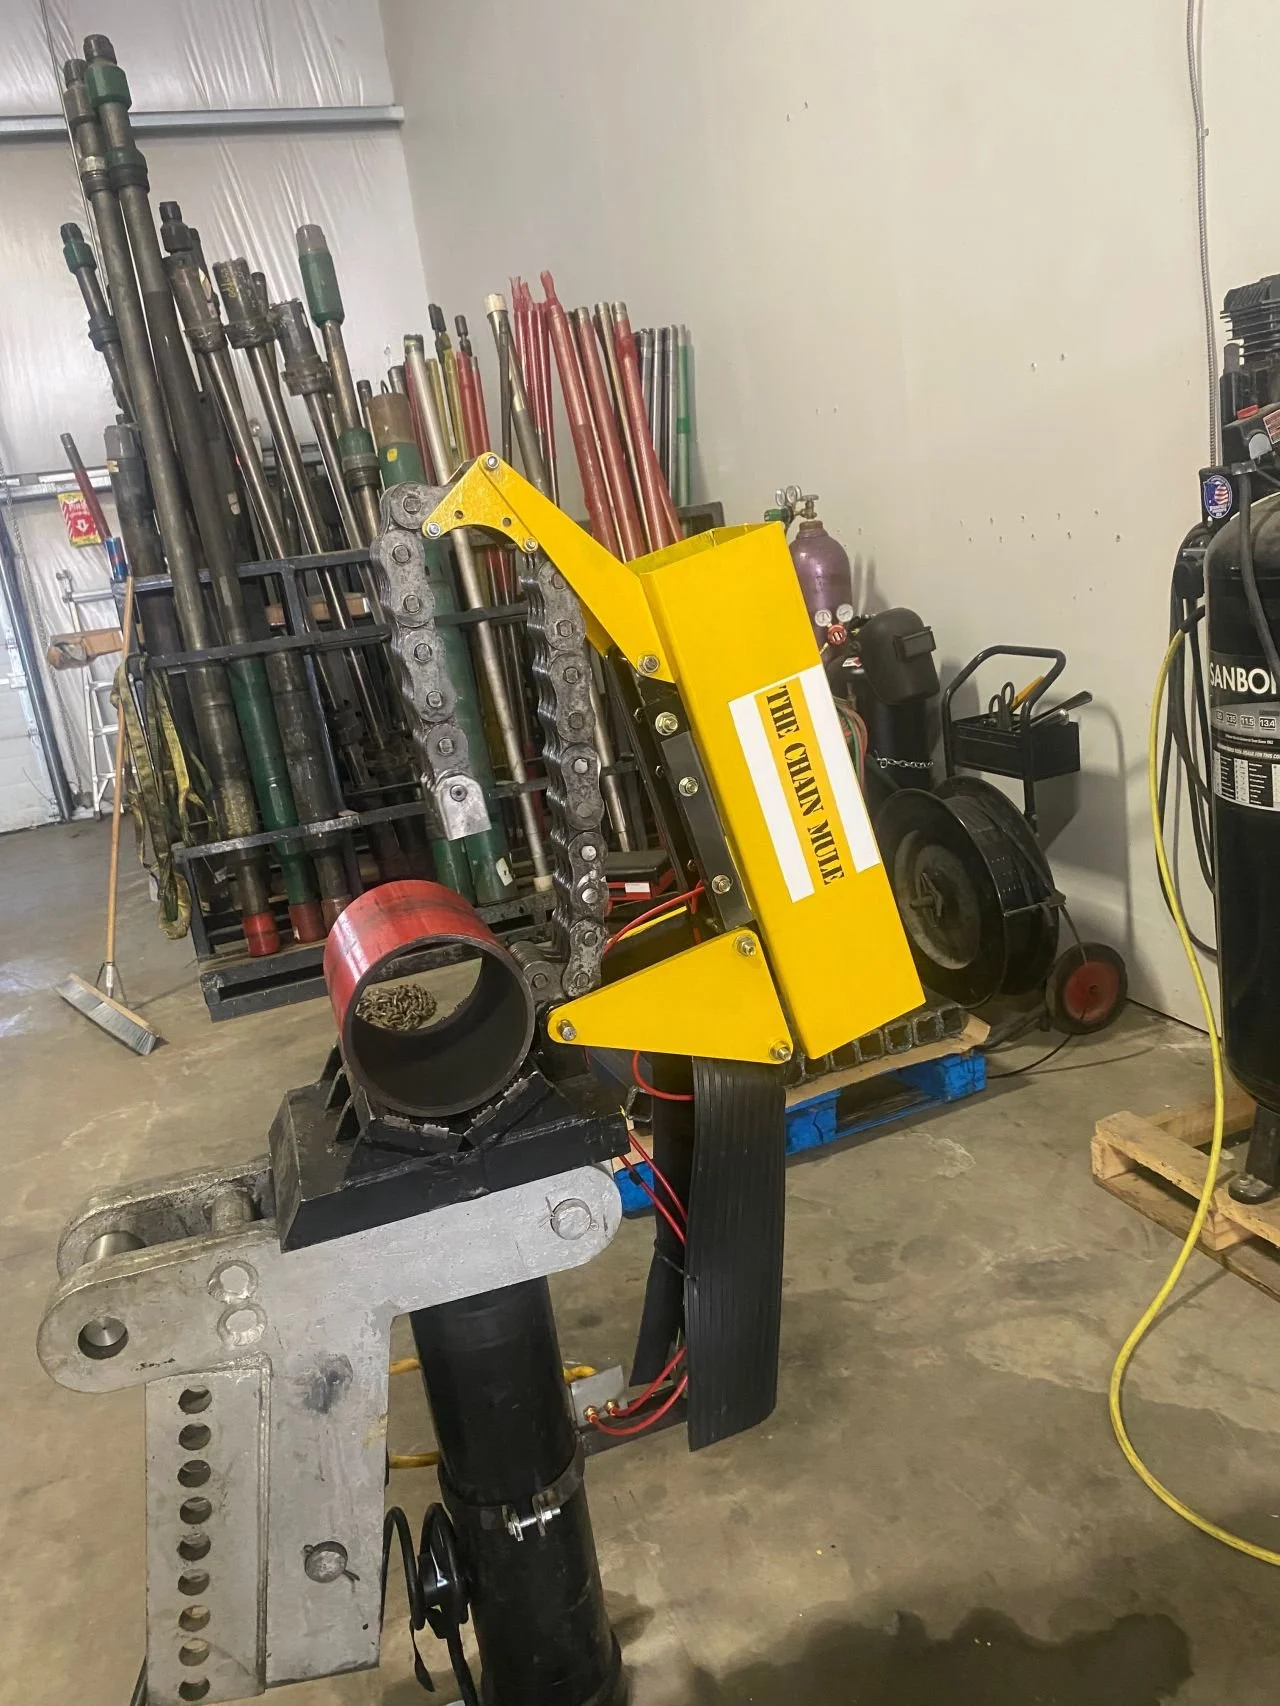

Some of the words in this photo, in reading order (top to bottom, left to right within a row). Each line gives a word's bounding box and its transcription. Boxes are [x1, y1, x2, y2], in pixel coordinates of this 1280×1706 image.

[1260, 719, 1275, 727] 13.4
[766, 685, 800, 738] THE
[784, 742, 824, 817] CHAIN
[807, 819, 845, 885] MULE
